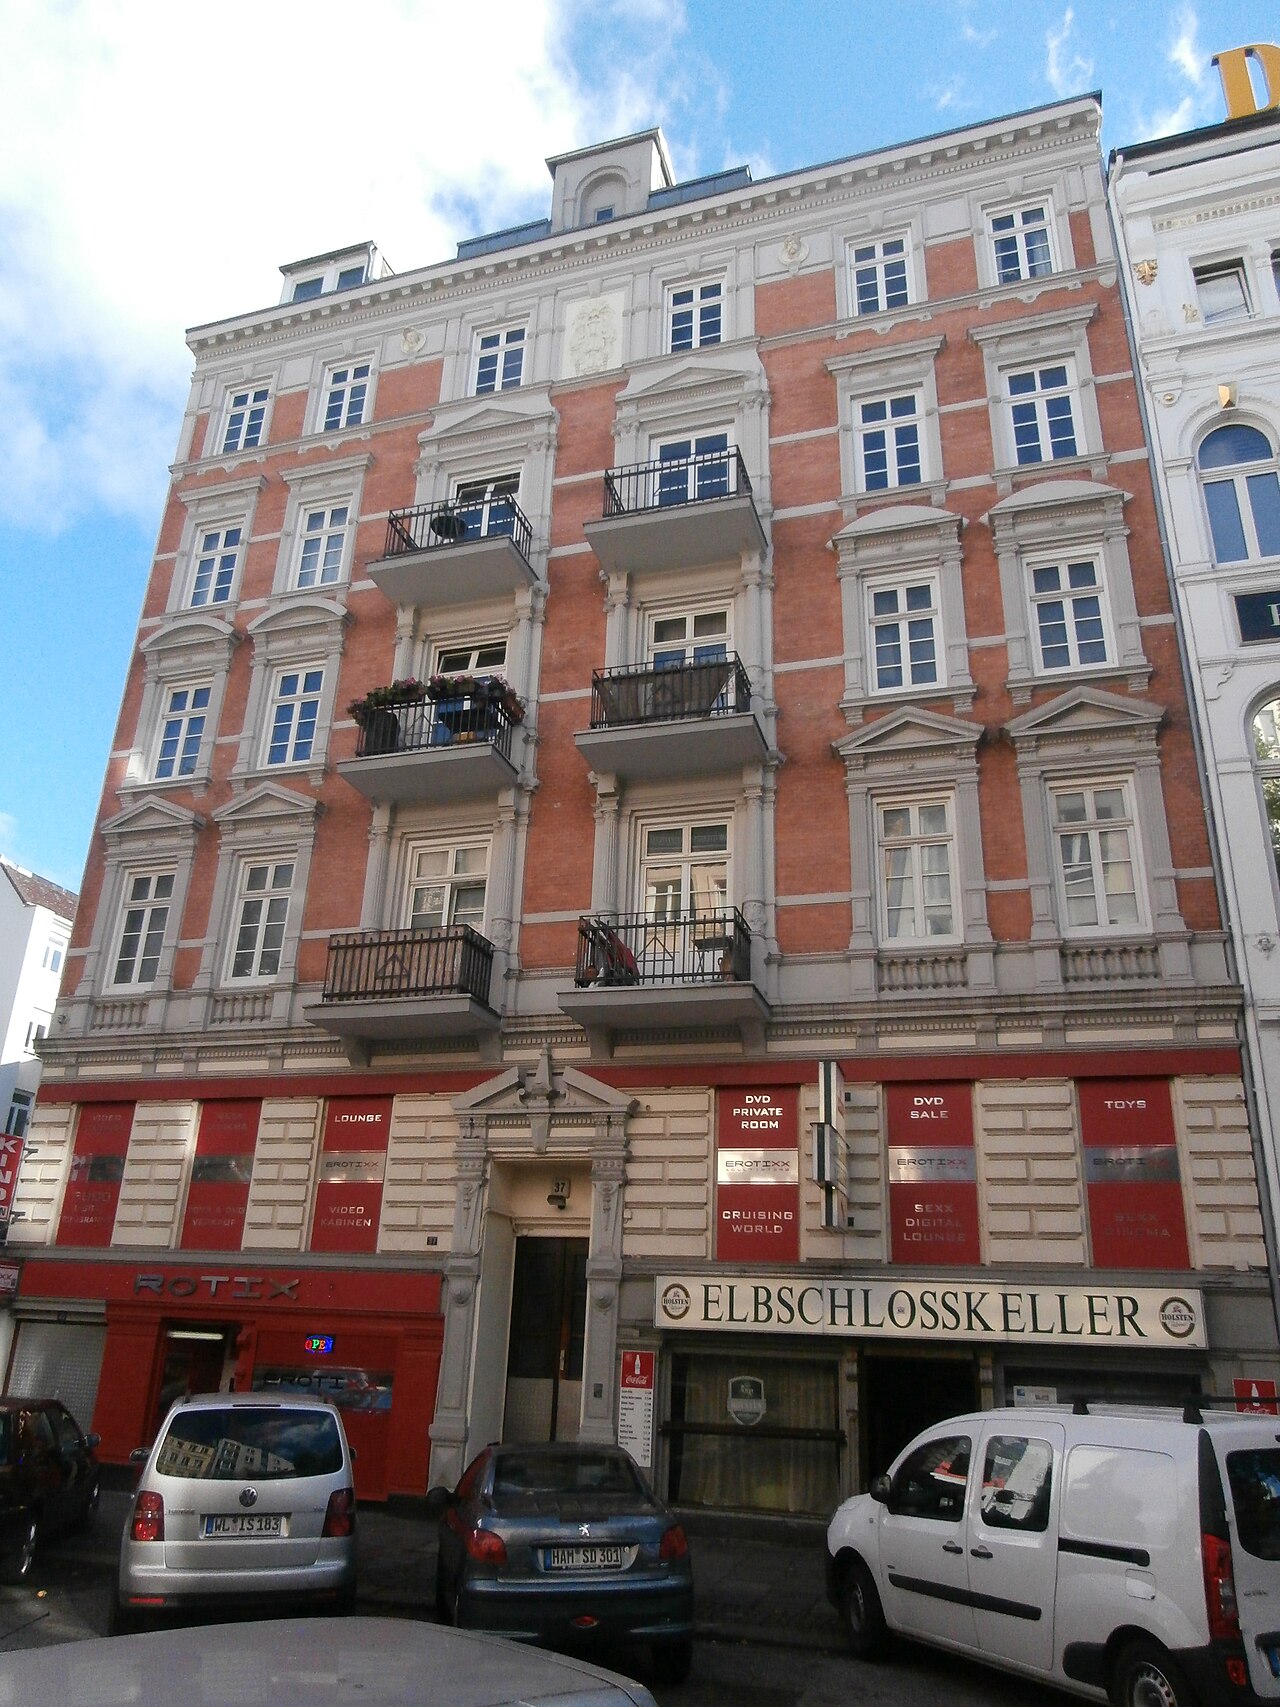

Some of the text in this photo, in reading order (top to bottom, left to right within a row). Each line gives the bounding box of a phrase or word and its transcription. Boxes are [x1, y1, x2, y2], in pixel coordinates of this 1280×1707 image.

[745, 1095, 771, 1104] DVD
[913, 1097, 944, 1106] DVD
[1104, 1100, 1147, 1109] TOYS
[733, 1107, 783, 1117] PRIVATE
[910, 1110, 949, 1119] SALE
[334, 1114, 382, 1123] LOUNGE
[741, 1120, 779, 1129] ROOM
[325, 1160, 379, 1169] EROTIXX
[725, 1160, 790, 1168] EROTIXX
[896, 1157, 968, 1166] EROTIXX
[553, 1182, 566, 1193] 37
[330, 1205, 365, 1214] VIDEO
[914, 1203, 953, 1213] SEXX
[722, 1210, 793, 1220] CRUISING
[320, 1218, 372, 1227] KABINEN
[905, 1218, 962, 1227] DIGITAL
[731, 1224, 783, 1234] WORLD
[903, 1231, 967, 1242] LOUNGE
[133, 1274, 300, 1300] ROTIX
[701, 1284, 1148, 1338] ELBSCHLOSSKELLER
[1161, 1313, 1194, 1321] HOLSTEN
[304, 1338, 333, 1351] OPEN
[214, 1518, 230, 1532] WL
[552, 1548, 574, 1564] HAM
[600, 1547, 620, 1562] 301
